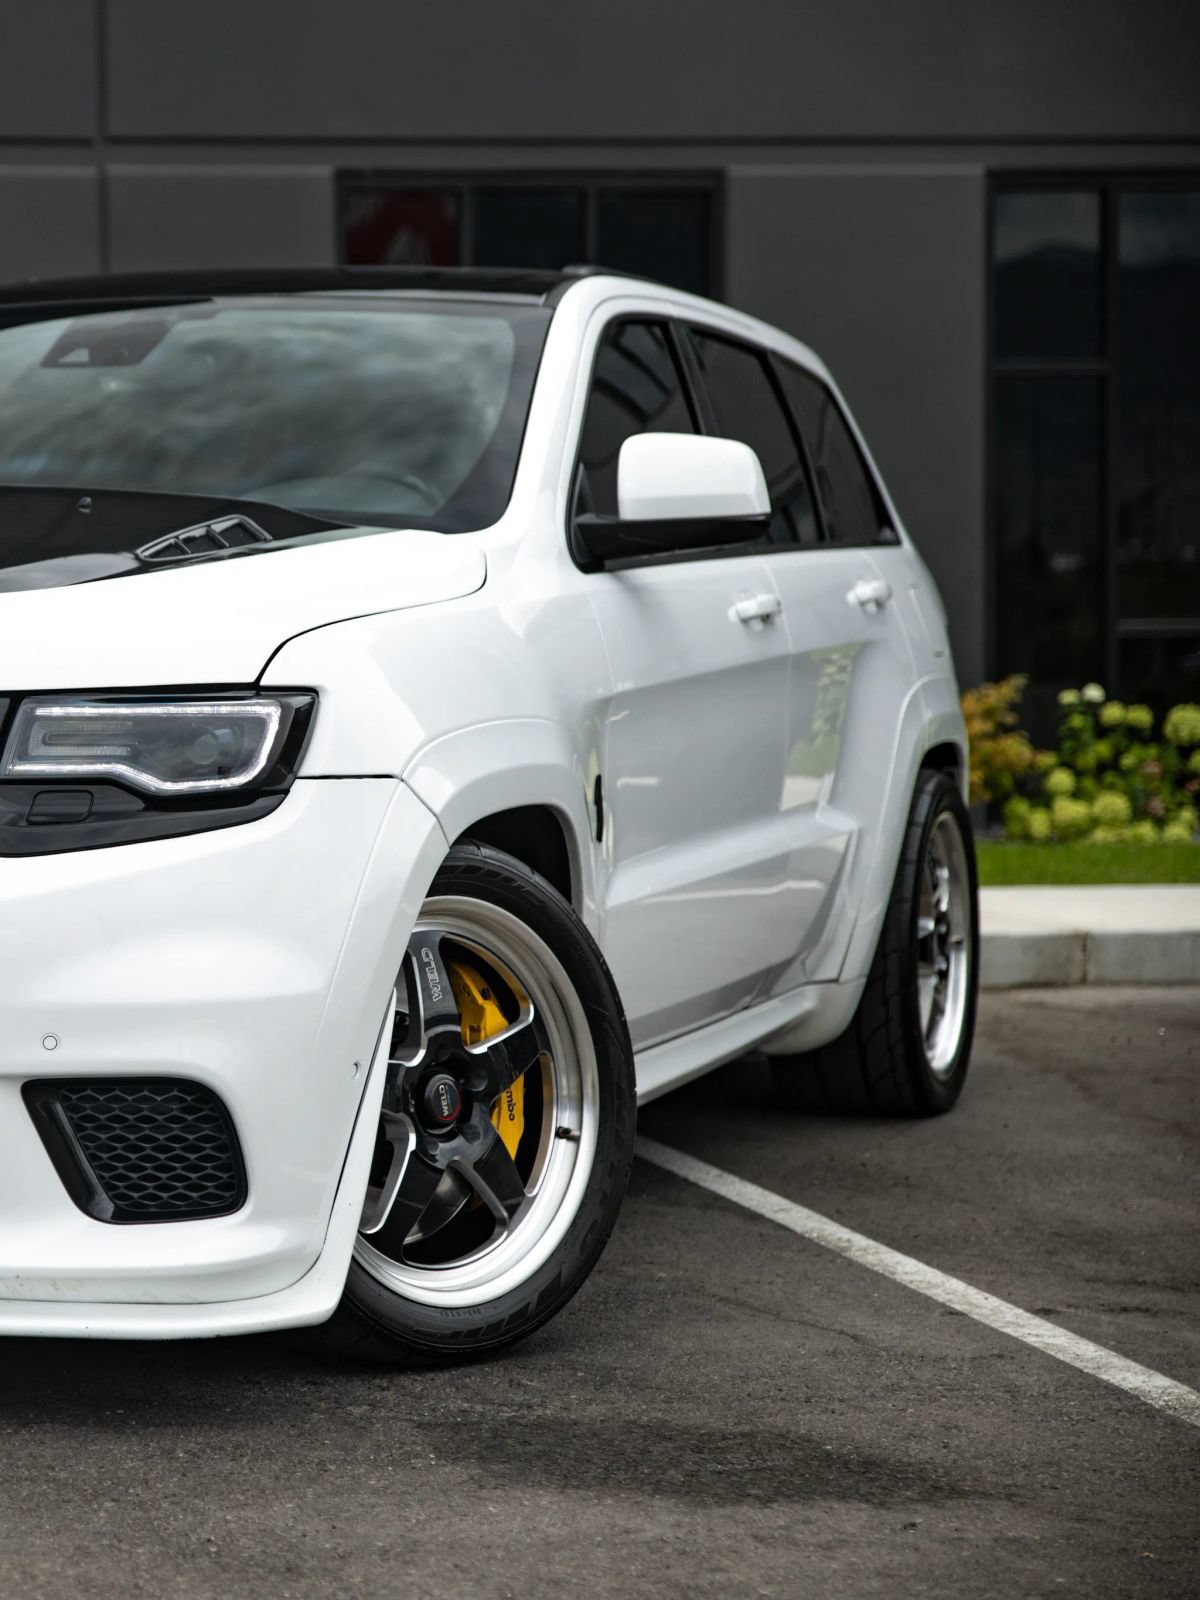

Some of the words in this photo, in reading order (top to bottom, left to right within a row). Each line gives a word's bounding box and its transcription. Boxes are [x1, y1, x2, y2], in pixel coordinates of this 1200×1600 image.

[421, 947, 442, 1001] WELD
[438, 1084, 449, 1117] WELD
[506, 1089, 516, 1121] mbo
